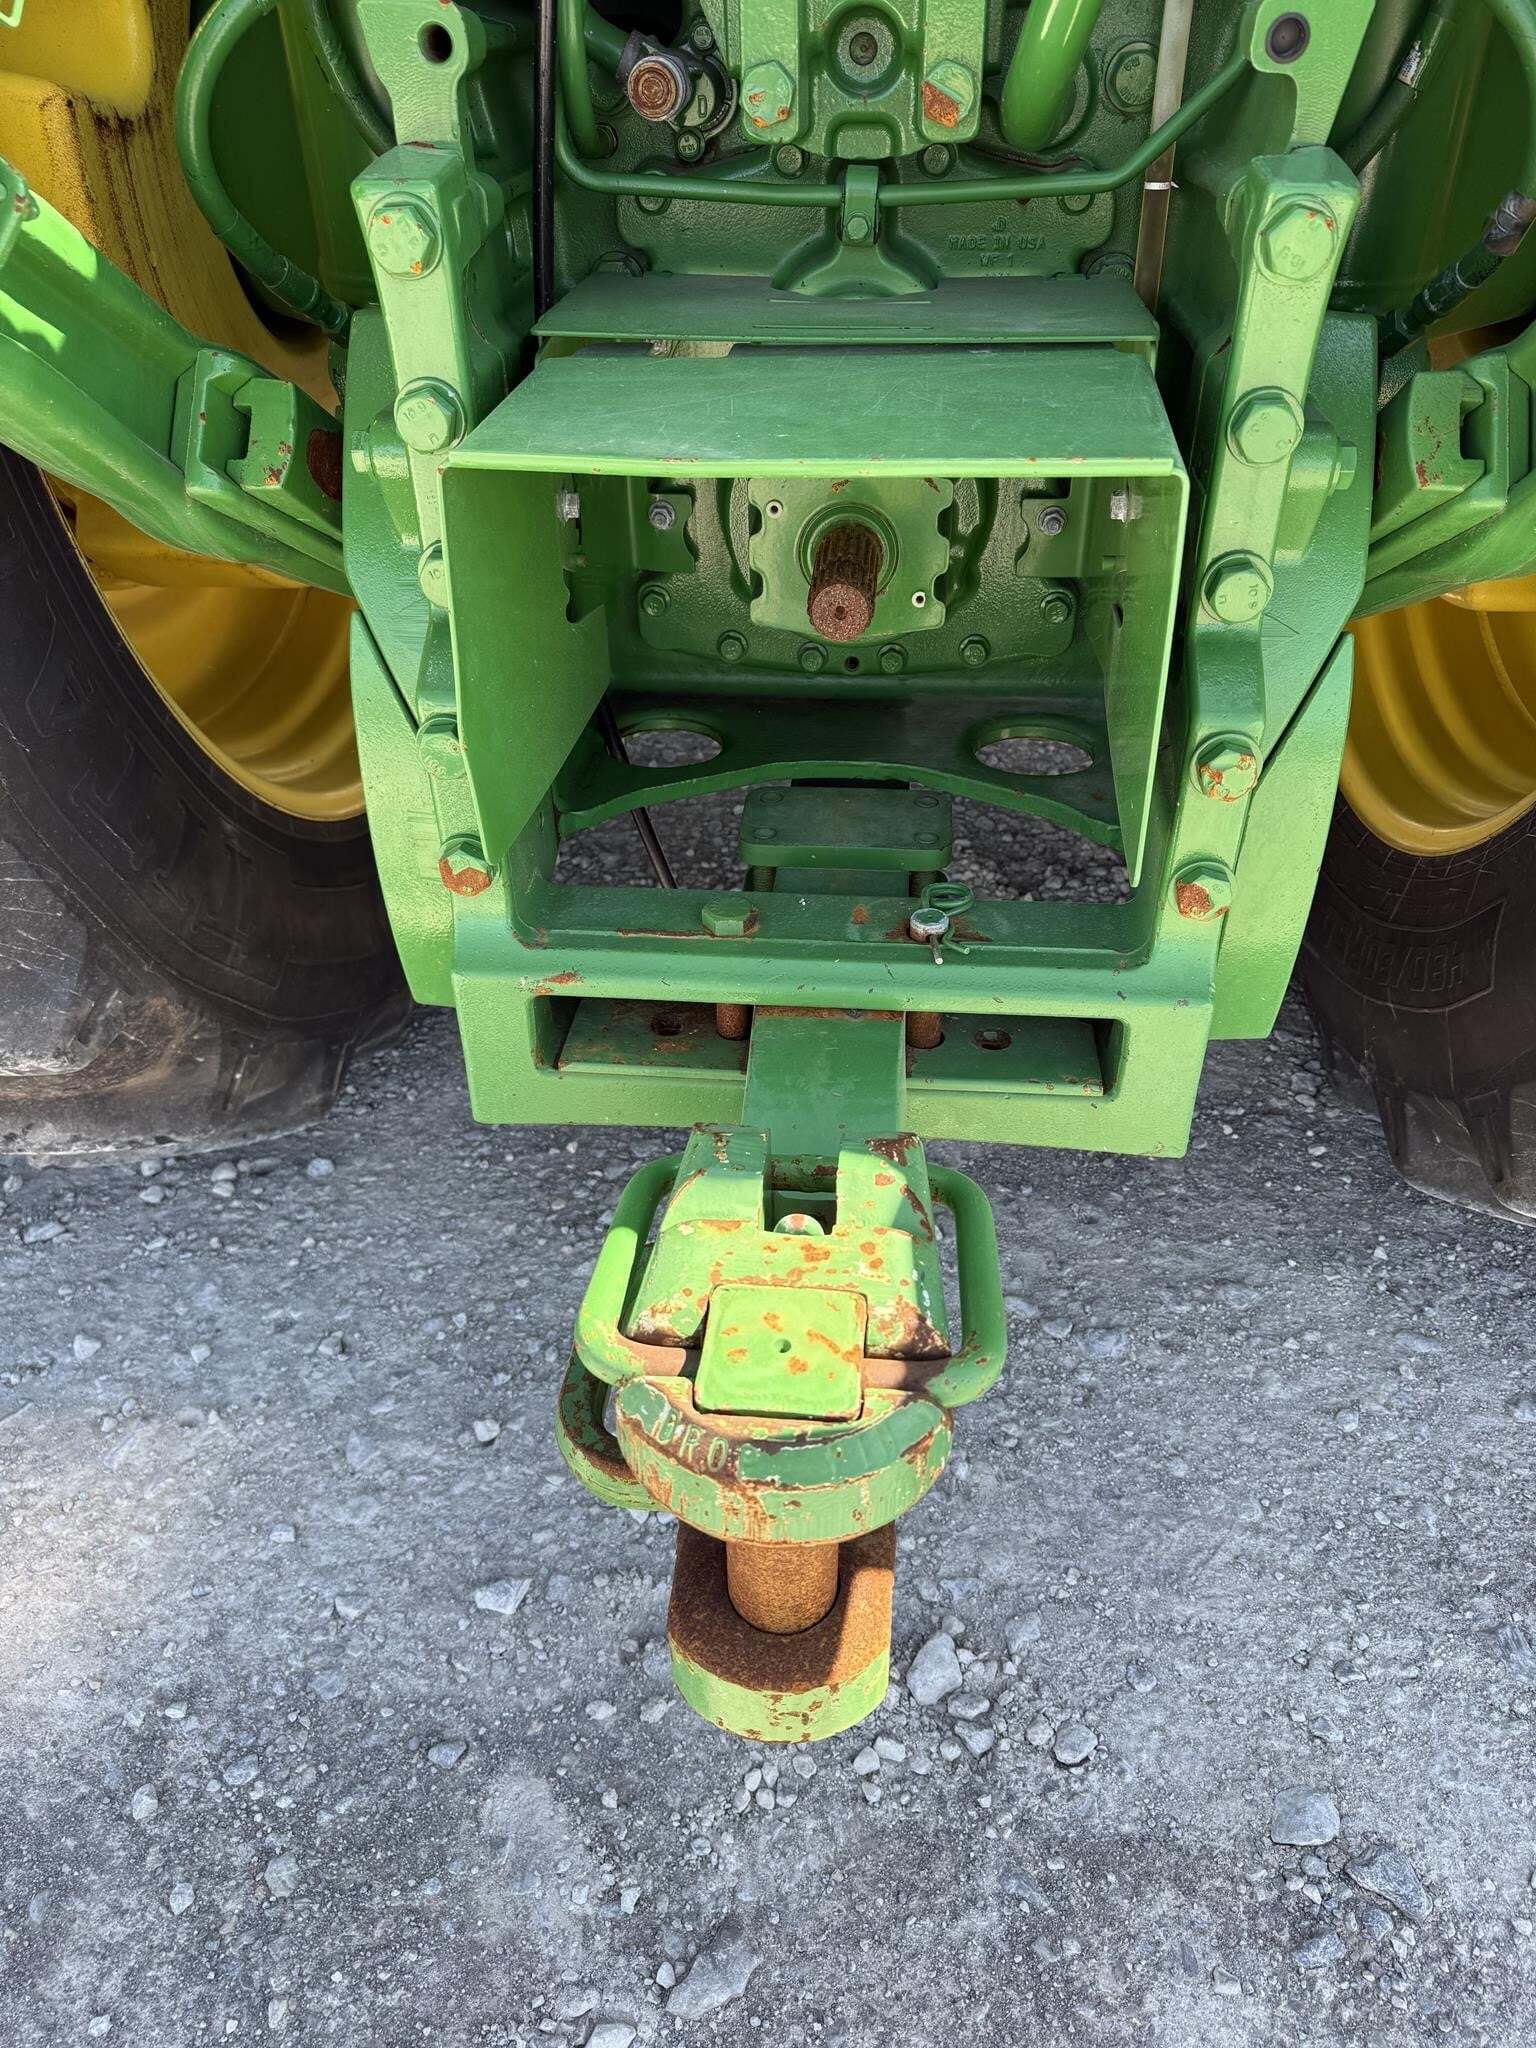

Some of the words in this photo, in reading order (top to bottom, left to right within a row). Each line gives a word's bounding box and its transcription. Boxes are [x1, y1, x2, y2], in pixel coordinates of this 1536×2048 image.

[948, 233, 986, 250] MADE
[993, 234, 1012, 250] IN
[1018, 235, 1047, 250] USA
